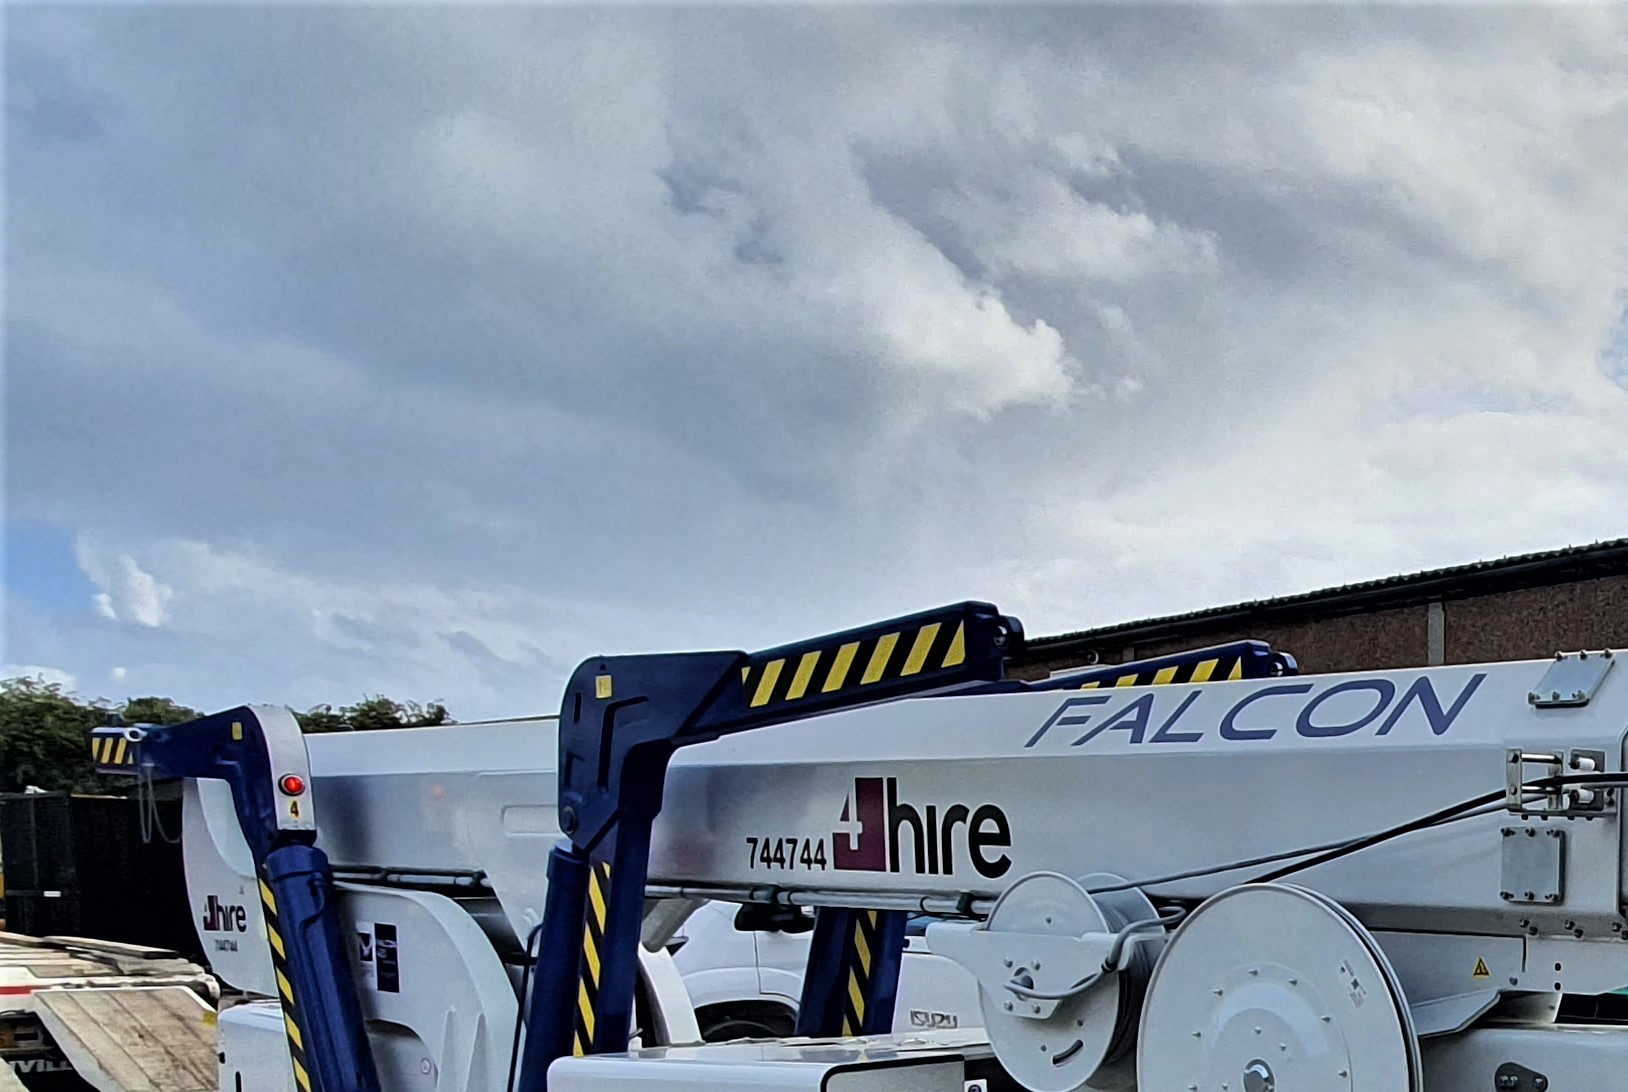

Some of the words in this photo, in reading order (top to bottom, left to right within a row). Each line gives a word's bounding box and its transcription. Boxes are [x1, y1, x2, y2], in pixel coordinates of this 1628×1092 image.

[1024, 674, 1487, 748] FALCON
[290, 801, 299, 818] 4
[746, 837, 828, 871] 744744
[832, 777, 1013, 879] 4hire
